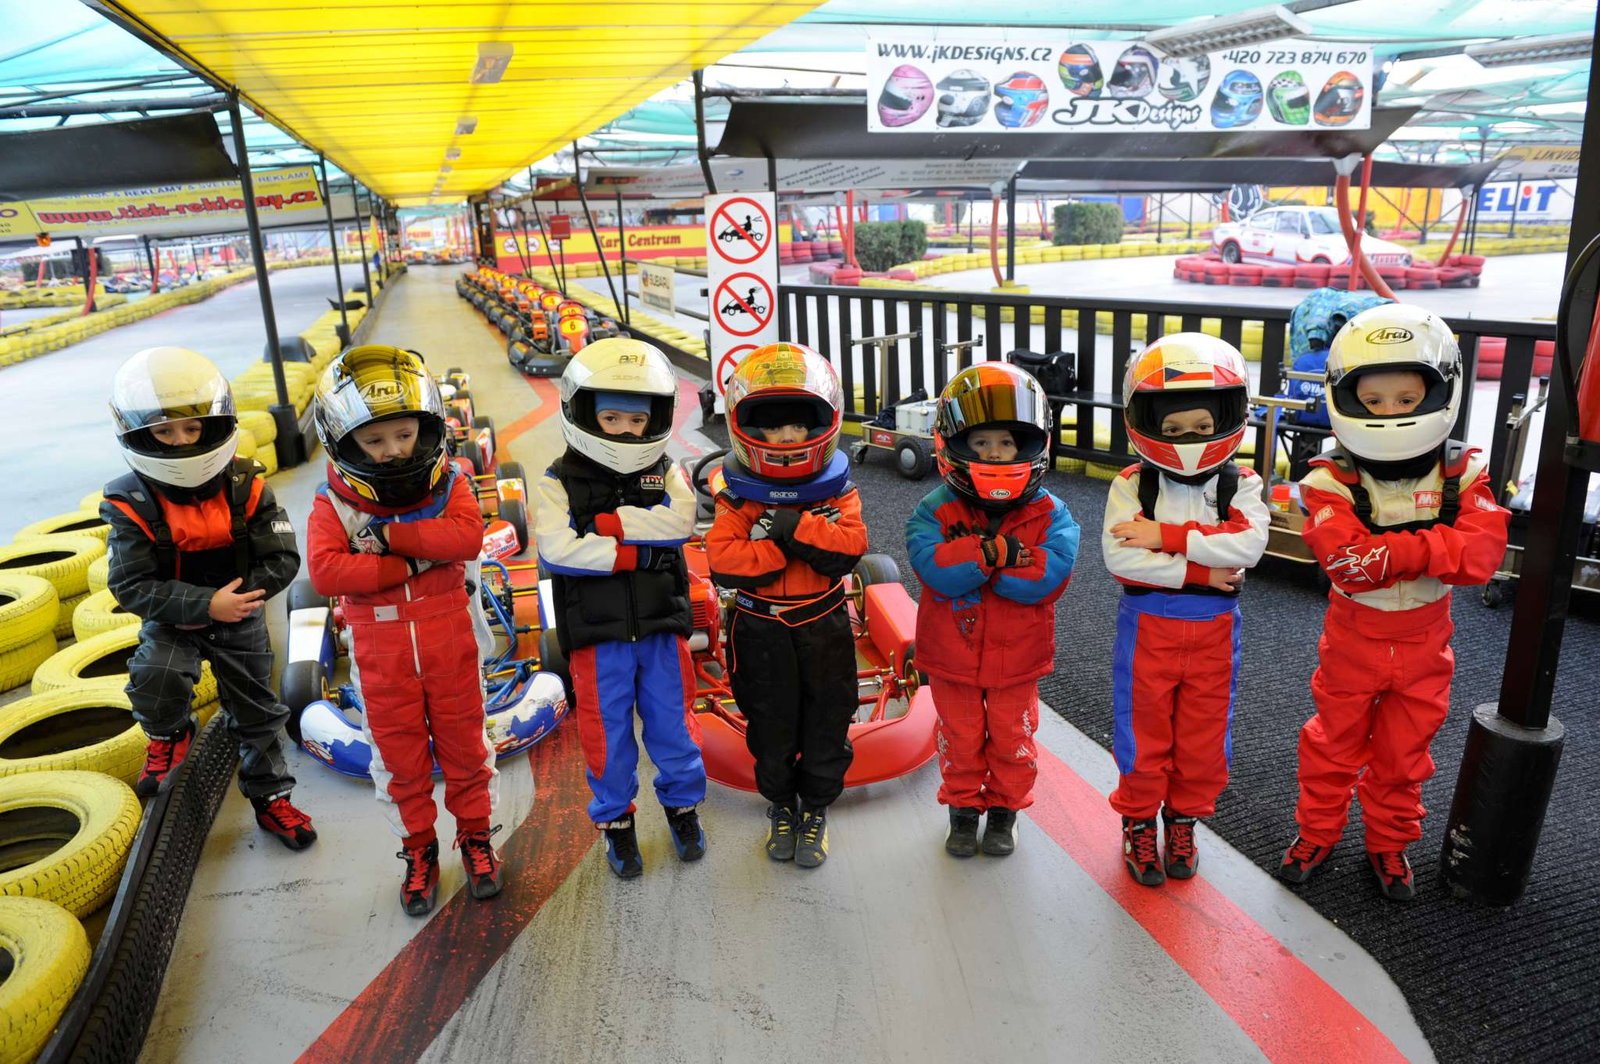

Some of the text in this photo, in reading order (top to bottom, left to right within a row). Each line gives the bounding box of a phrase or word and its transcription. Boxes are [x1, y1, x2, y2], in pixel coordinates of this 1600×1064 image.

[1222, 51, 1367, 65] +420 723 874 670
[627, 234, 682, 247] Centrum
[570, 320, 576, 331] 6
[1375, 328, 1409, 341] Arai
[364, 382, 402, 399] Arai
